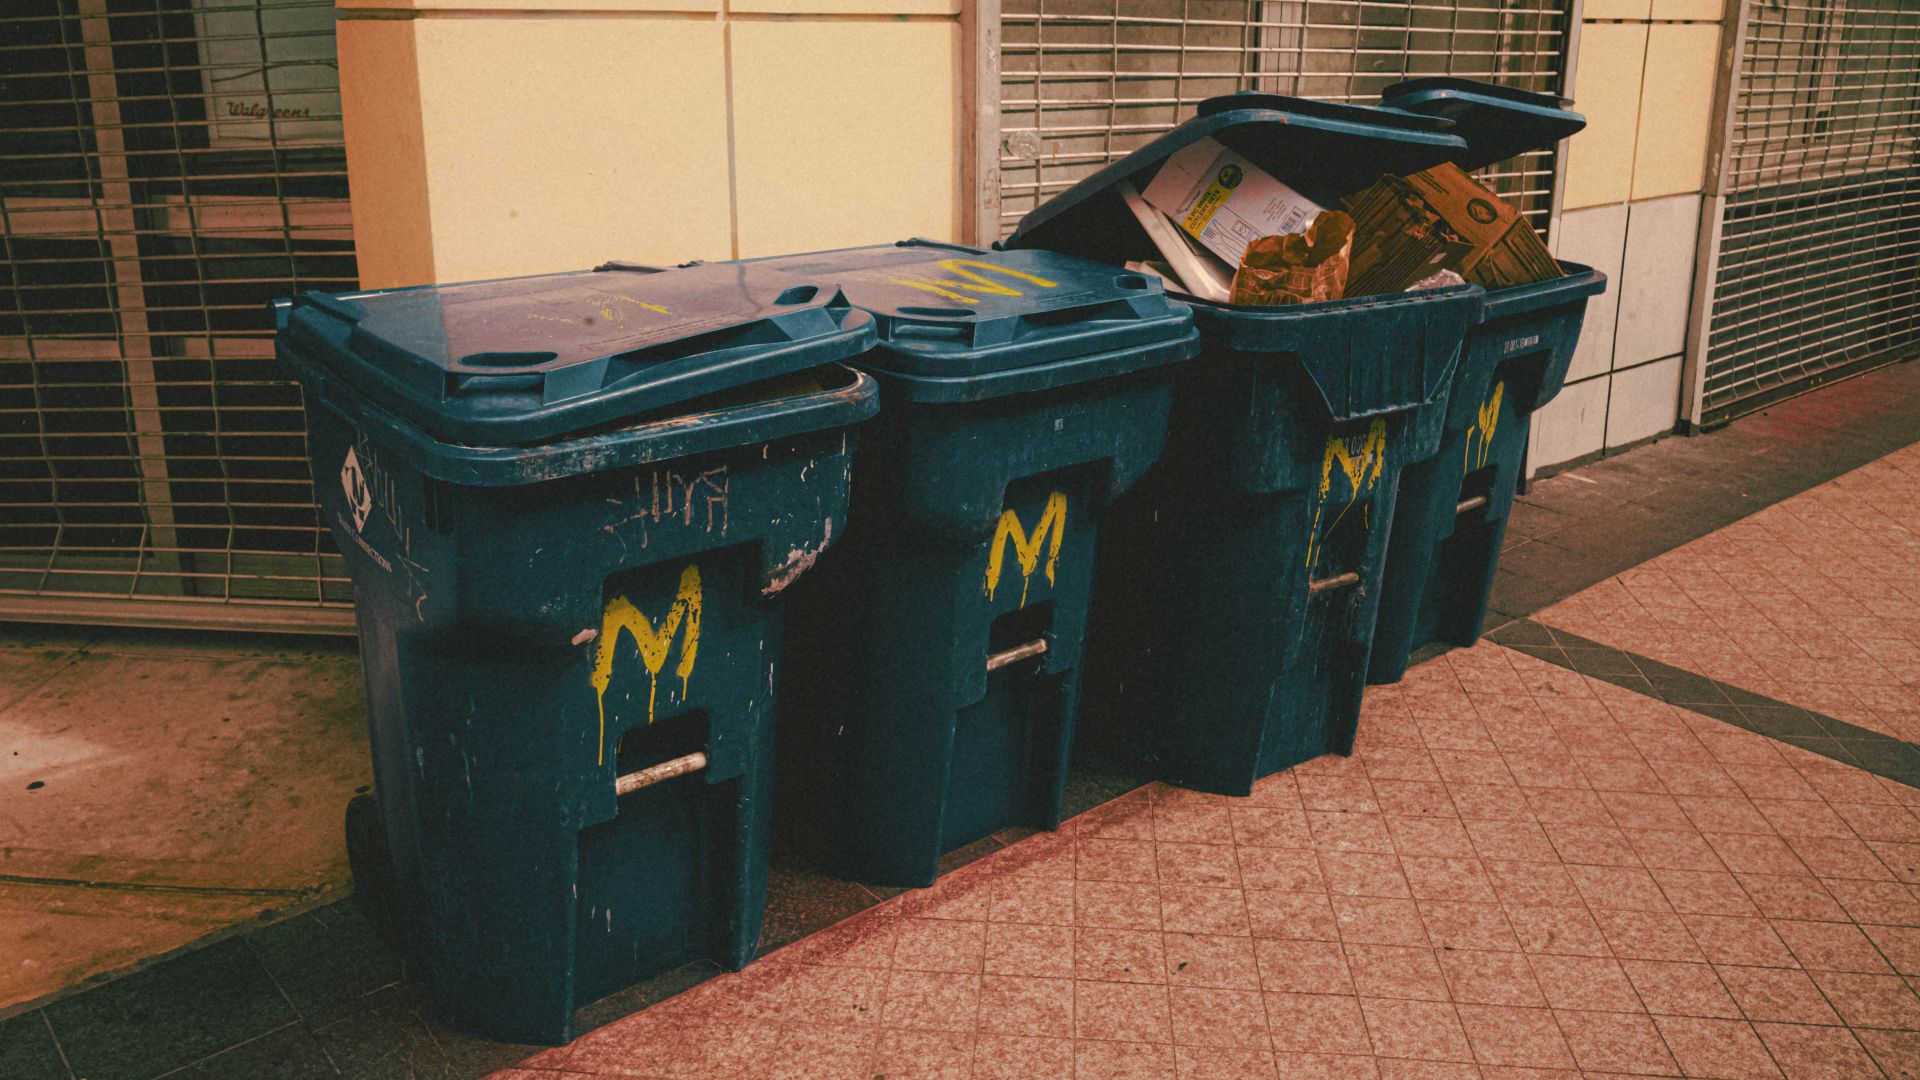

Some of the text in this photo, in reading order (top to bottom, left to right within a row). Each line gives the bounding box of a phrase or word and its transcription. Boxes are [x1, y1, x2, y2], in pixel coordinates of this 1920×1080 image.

[227, 101, 310, 119] Walgeens
[1190, 203, 1210, 230] CUTLERY
[1318, 416, 1387, 506] M
[983, 490, 1067, 604] M
[591, 563, 702, 708] M
